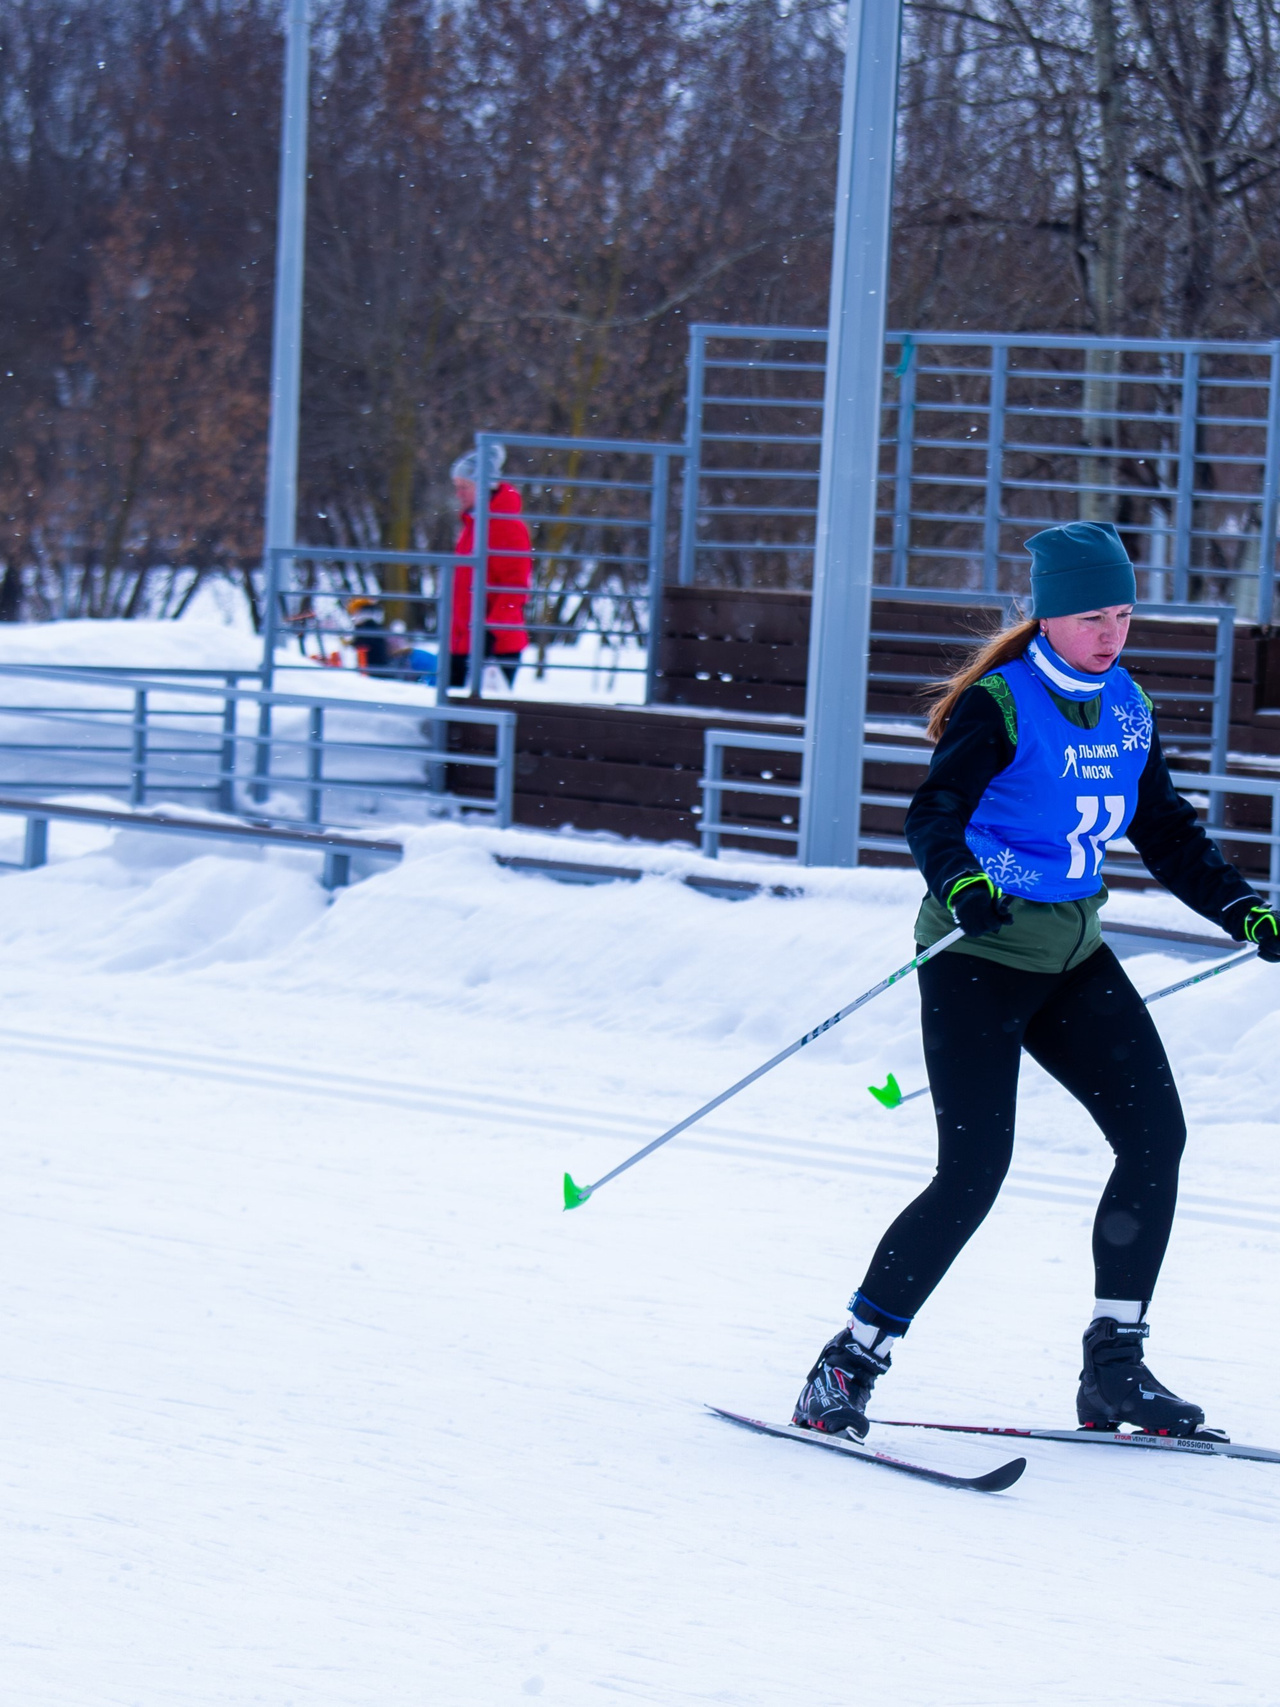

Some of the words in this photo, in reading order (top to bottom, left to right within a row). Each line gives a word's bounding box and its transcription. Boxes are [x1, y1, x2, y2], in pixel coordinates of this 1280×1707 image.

[1079, 744, 1119, 759] ЛЫЖНЯ
[1132, 1435, 1157, 1444] VENTURE
[1177, 1439, 1215, 1450] ROSSIGNOL
